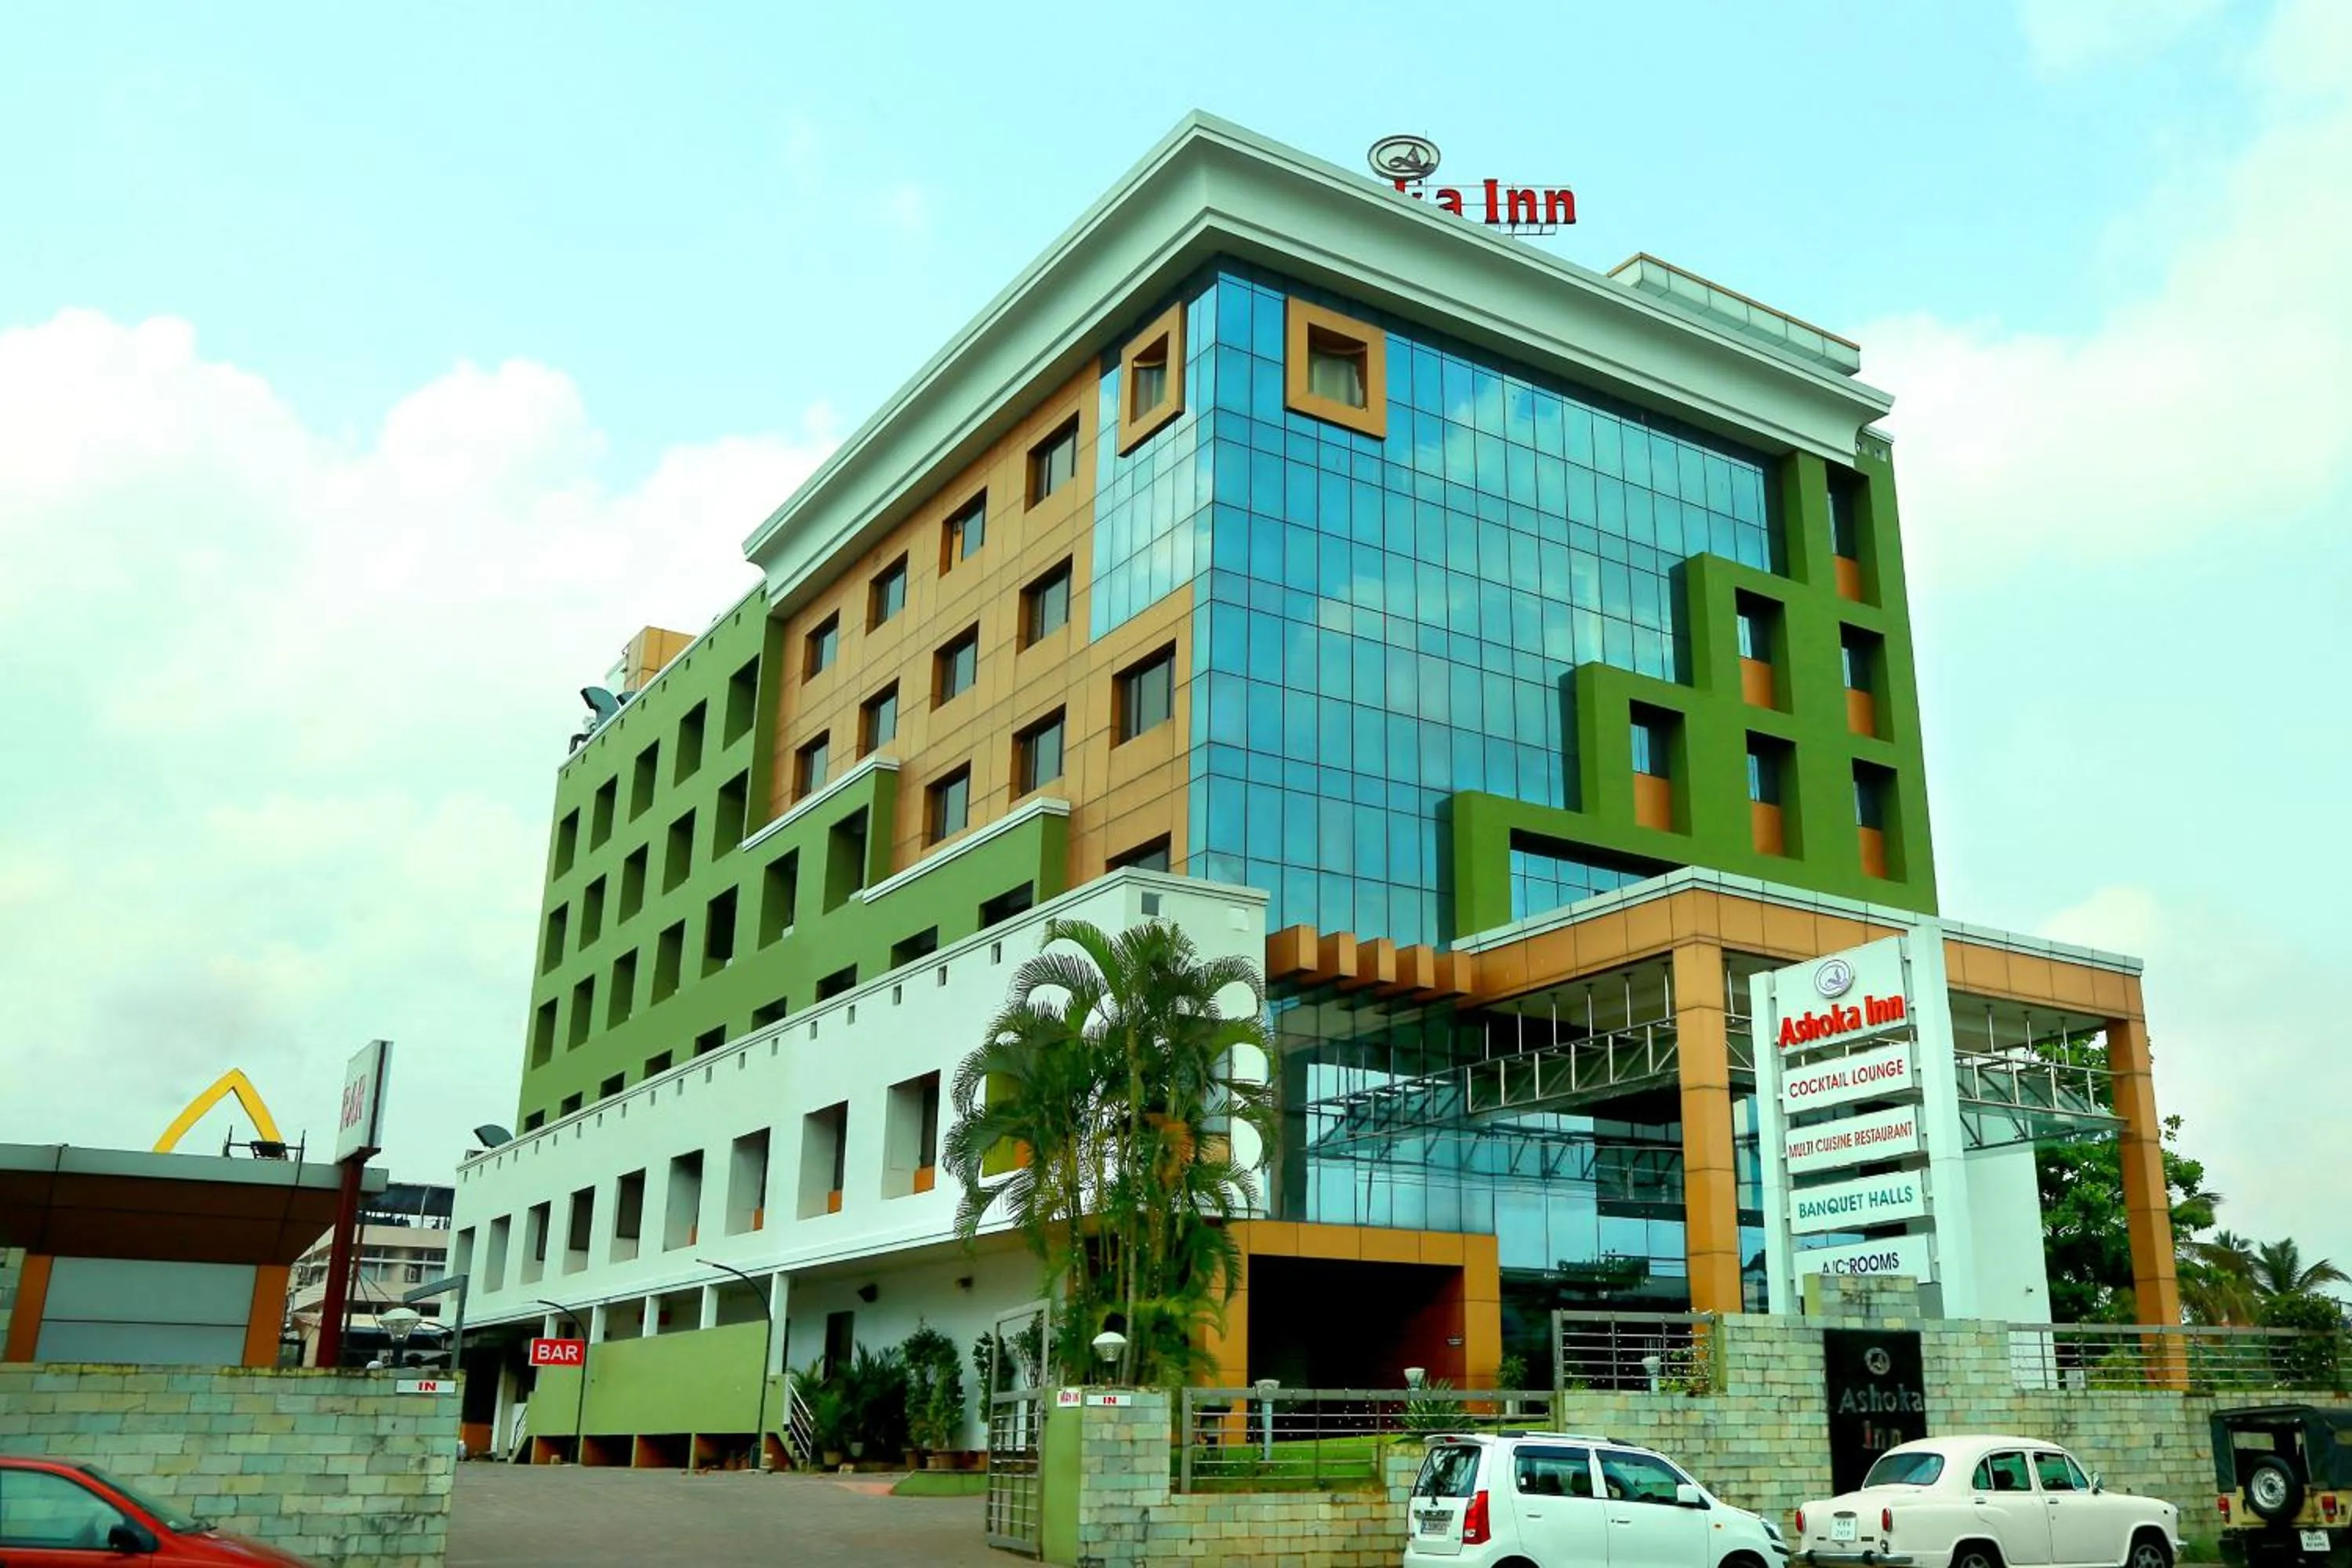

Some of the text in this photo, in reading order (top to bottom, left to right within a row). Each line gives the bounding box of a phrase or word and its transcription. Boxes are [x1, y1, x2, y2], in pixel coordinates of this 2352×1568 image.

[1483, 179, 1577, 224] Inn
[1778, 994, 1905, 1047] Ashoka Inn
[1789, 1059, 1904, 1098] COCKTAIL LOUNGE
[1788, 1121, 1913, 1158] MULTI CUISINE RESTAURANT
[1798, 1185, 1914, 1218] BANQUET HALLS
[1849, 1252, 1900, 1274] ROOMS
[537, 1345, 578, 1361] BAR
[418, 1381, 437, 1392] IN
[1837, 1383, 1924, 1414] Ashoka
